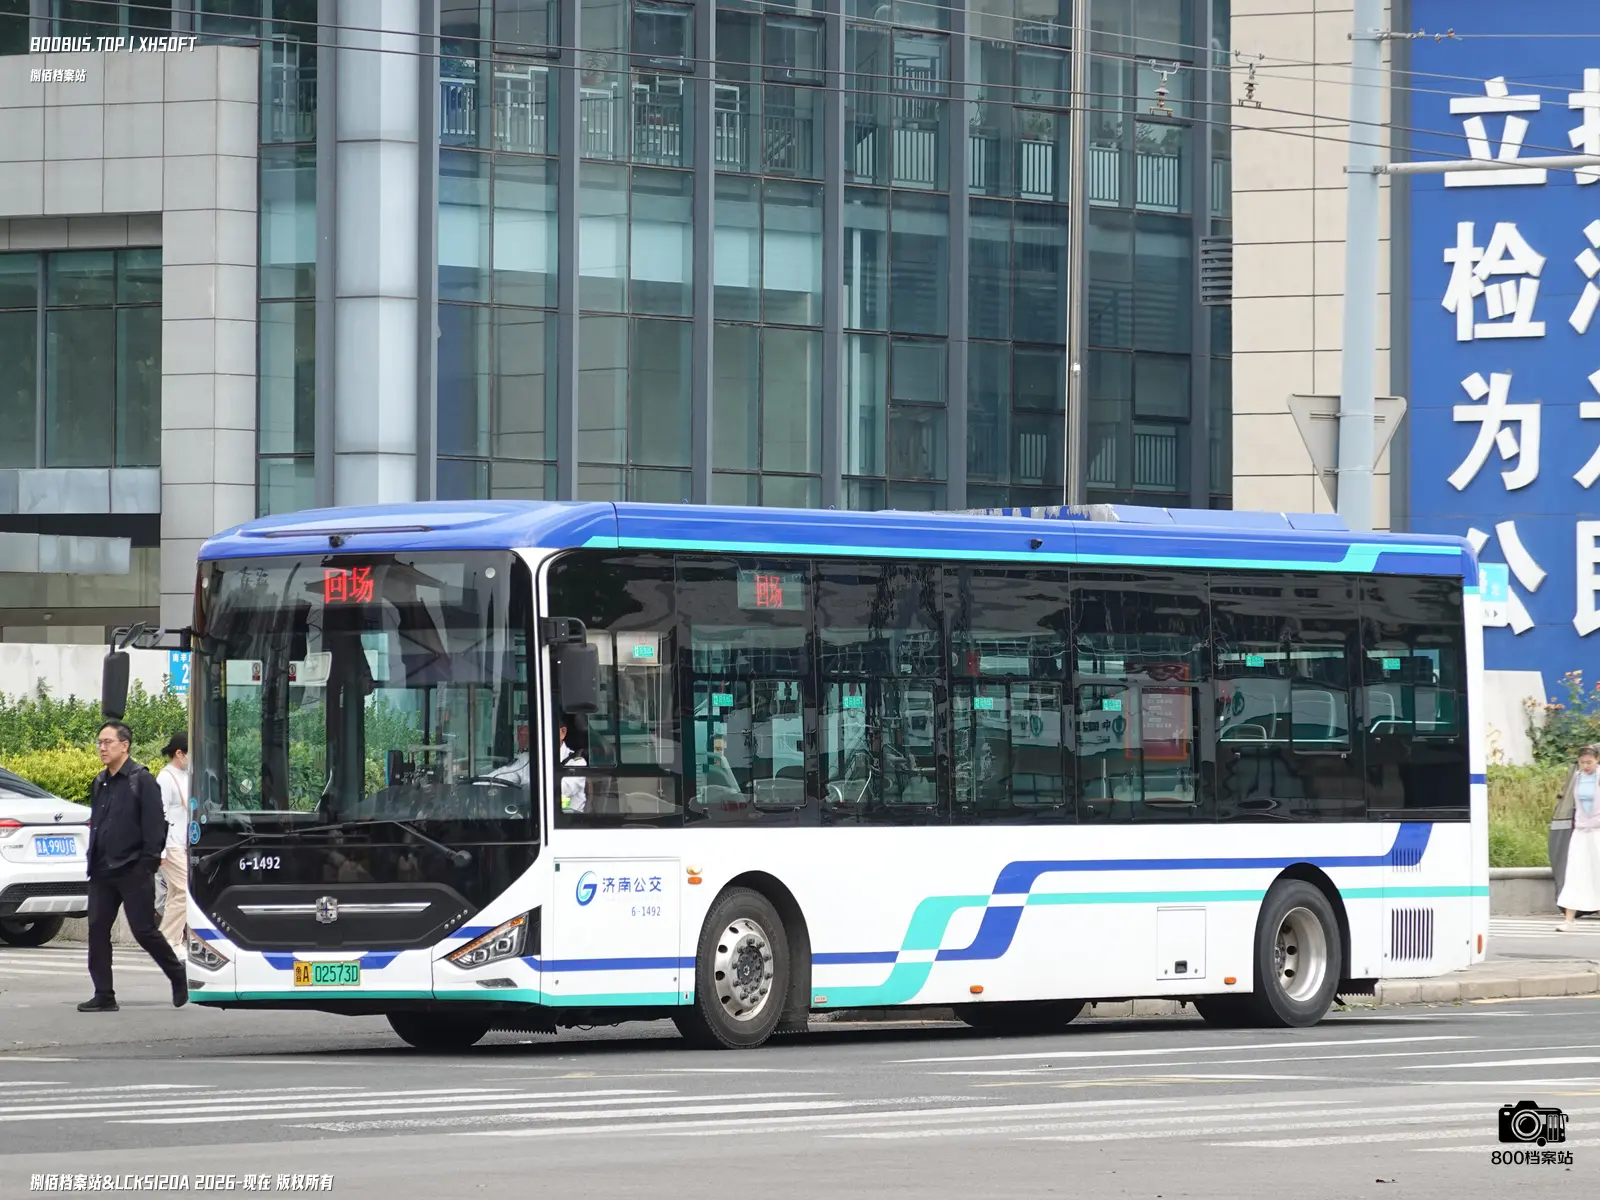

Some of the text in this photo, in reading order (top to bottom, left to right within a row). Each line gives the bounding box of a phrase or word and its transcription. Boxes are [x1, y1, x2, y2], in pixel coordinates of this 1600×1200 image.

[324, 565, 375, 604] 回场
[755, 575, 783, 607] 回场
[239, 856, 281, 870] 6-1492
[602, 876, 662, 893] 济南公交
[631, 906, 661, 917] 6-1492
